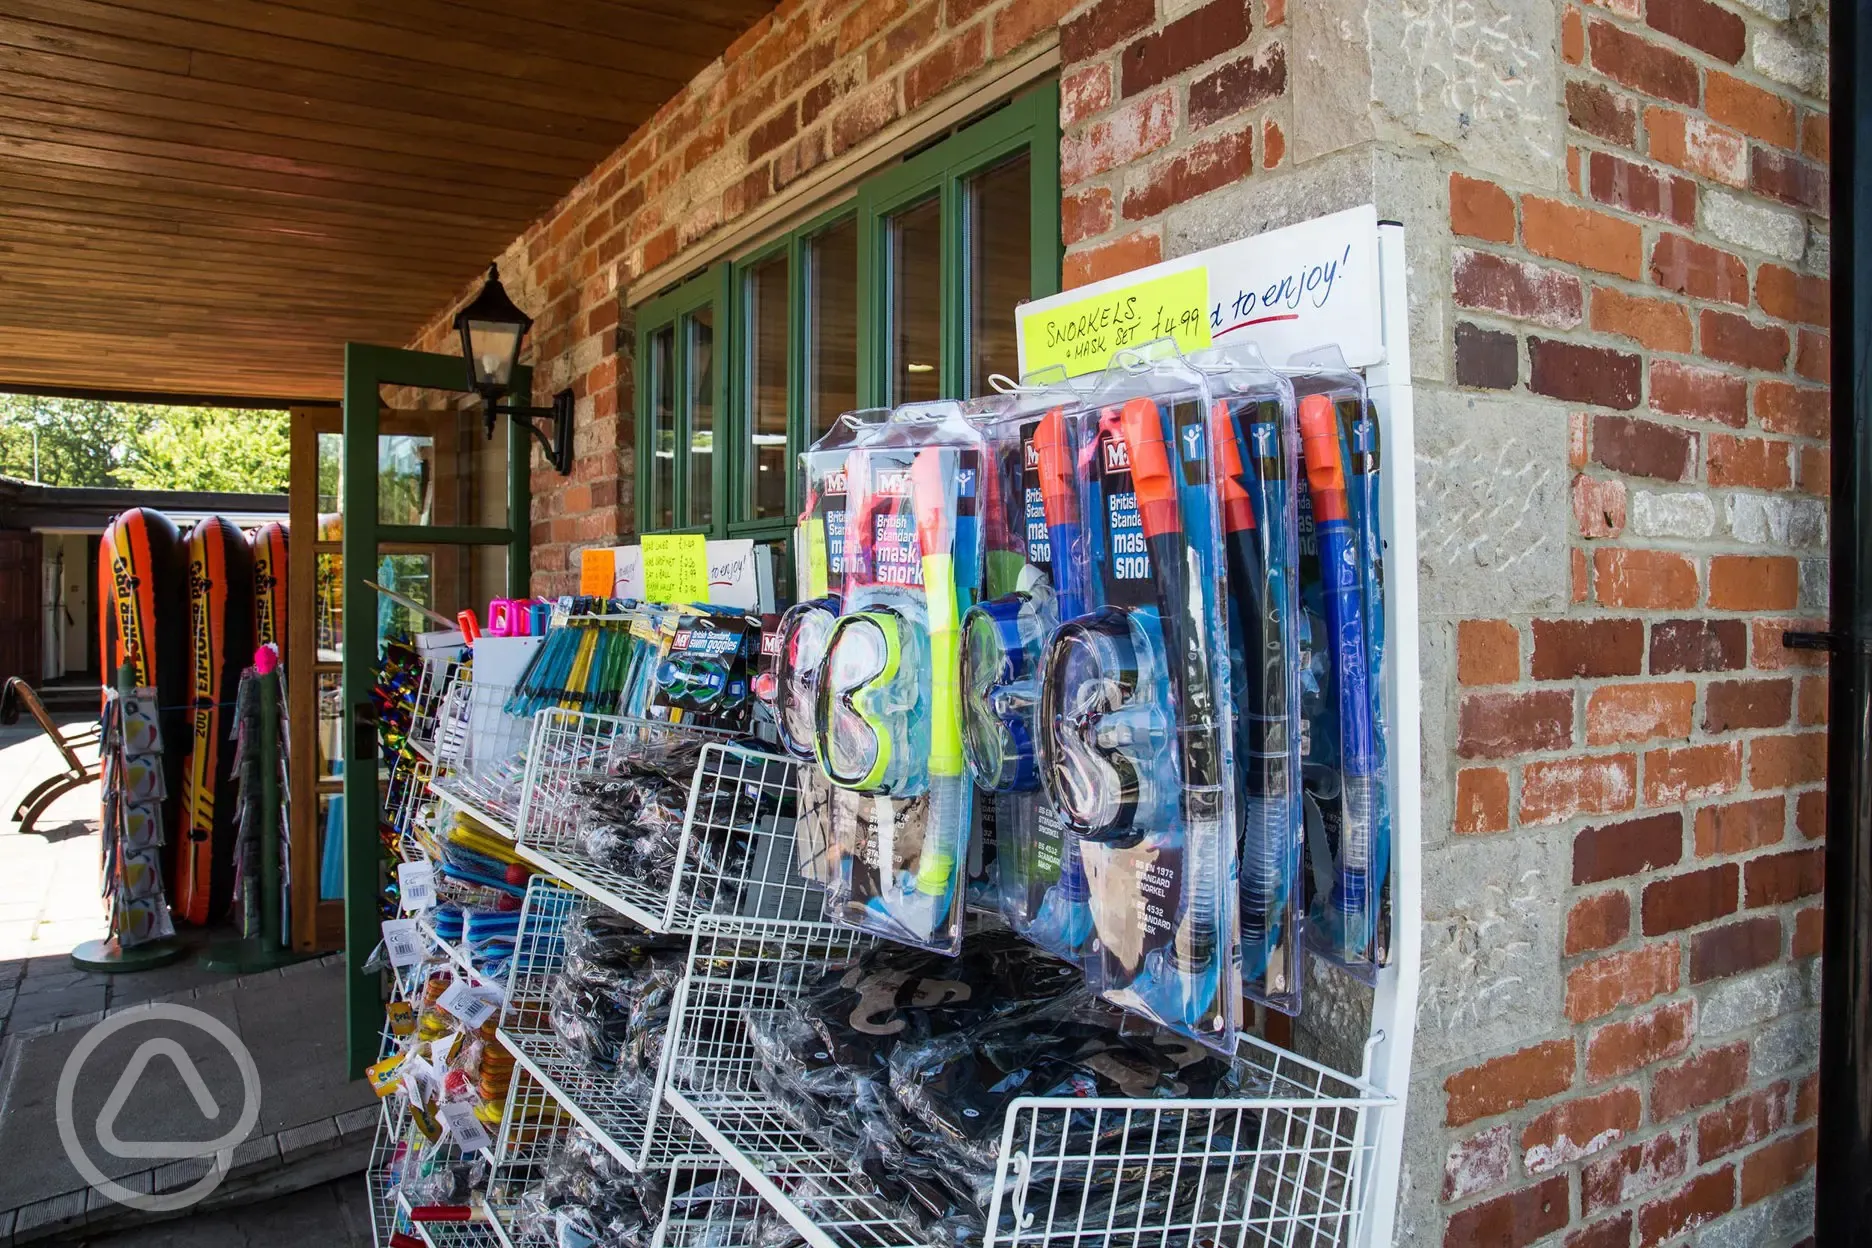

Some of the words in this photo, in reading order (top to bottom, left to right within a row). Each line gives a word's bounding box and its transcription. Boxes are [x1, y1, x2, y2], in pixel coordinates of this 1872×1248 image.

[1232, 290, 1256, 315] to
[1262, 244, 1350, 309] enjoy!
[1151, 305, 1199, 339] £4.99
[1075, 336, 1107, 359] MASK
[1115, 321, 1141, 346] SET
[877, 514, 906, 527] British
[693, 631, 707, 639] British
[689, 639, 707, 649] swim
[706, 640, 737, 653] goggles
[196, 712, 206, 737] 200
[1136, 870, 1170, 888] STANDARD
[1157, 867, 1174, 879] 1972
[1136, 881, 1166, 898] SNORKEL
[1147, 905, 1164, 917] 4532
[1137, 912, 1171, 930] STANDARD
[1137, 922, 1156, 935] MASK
